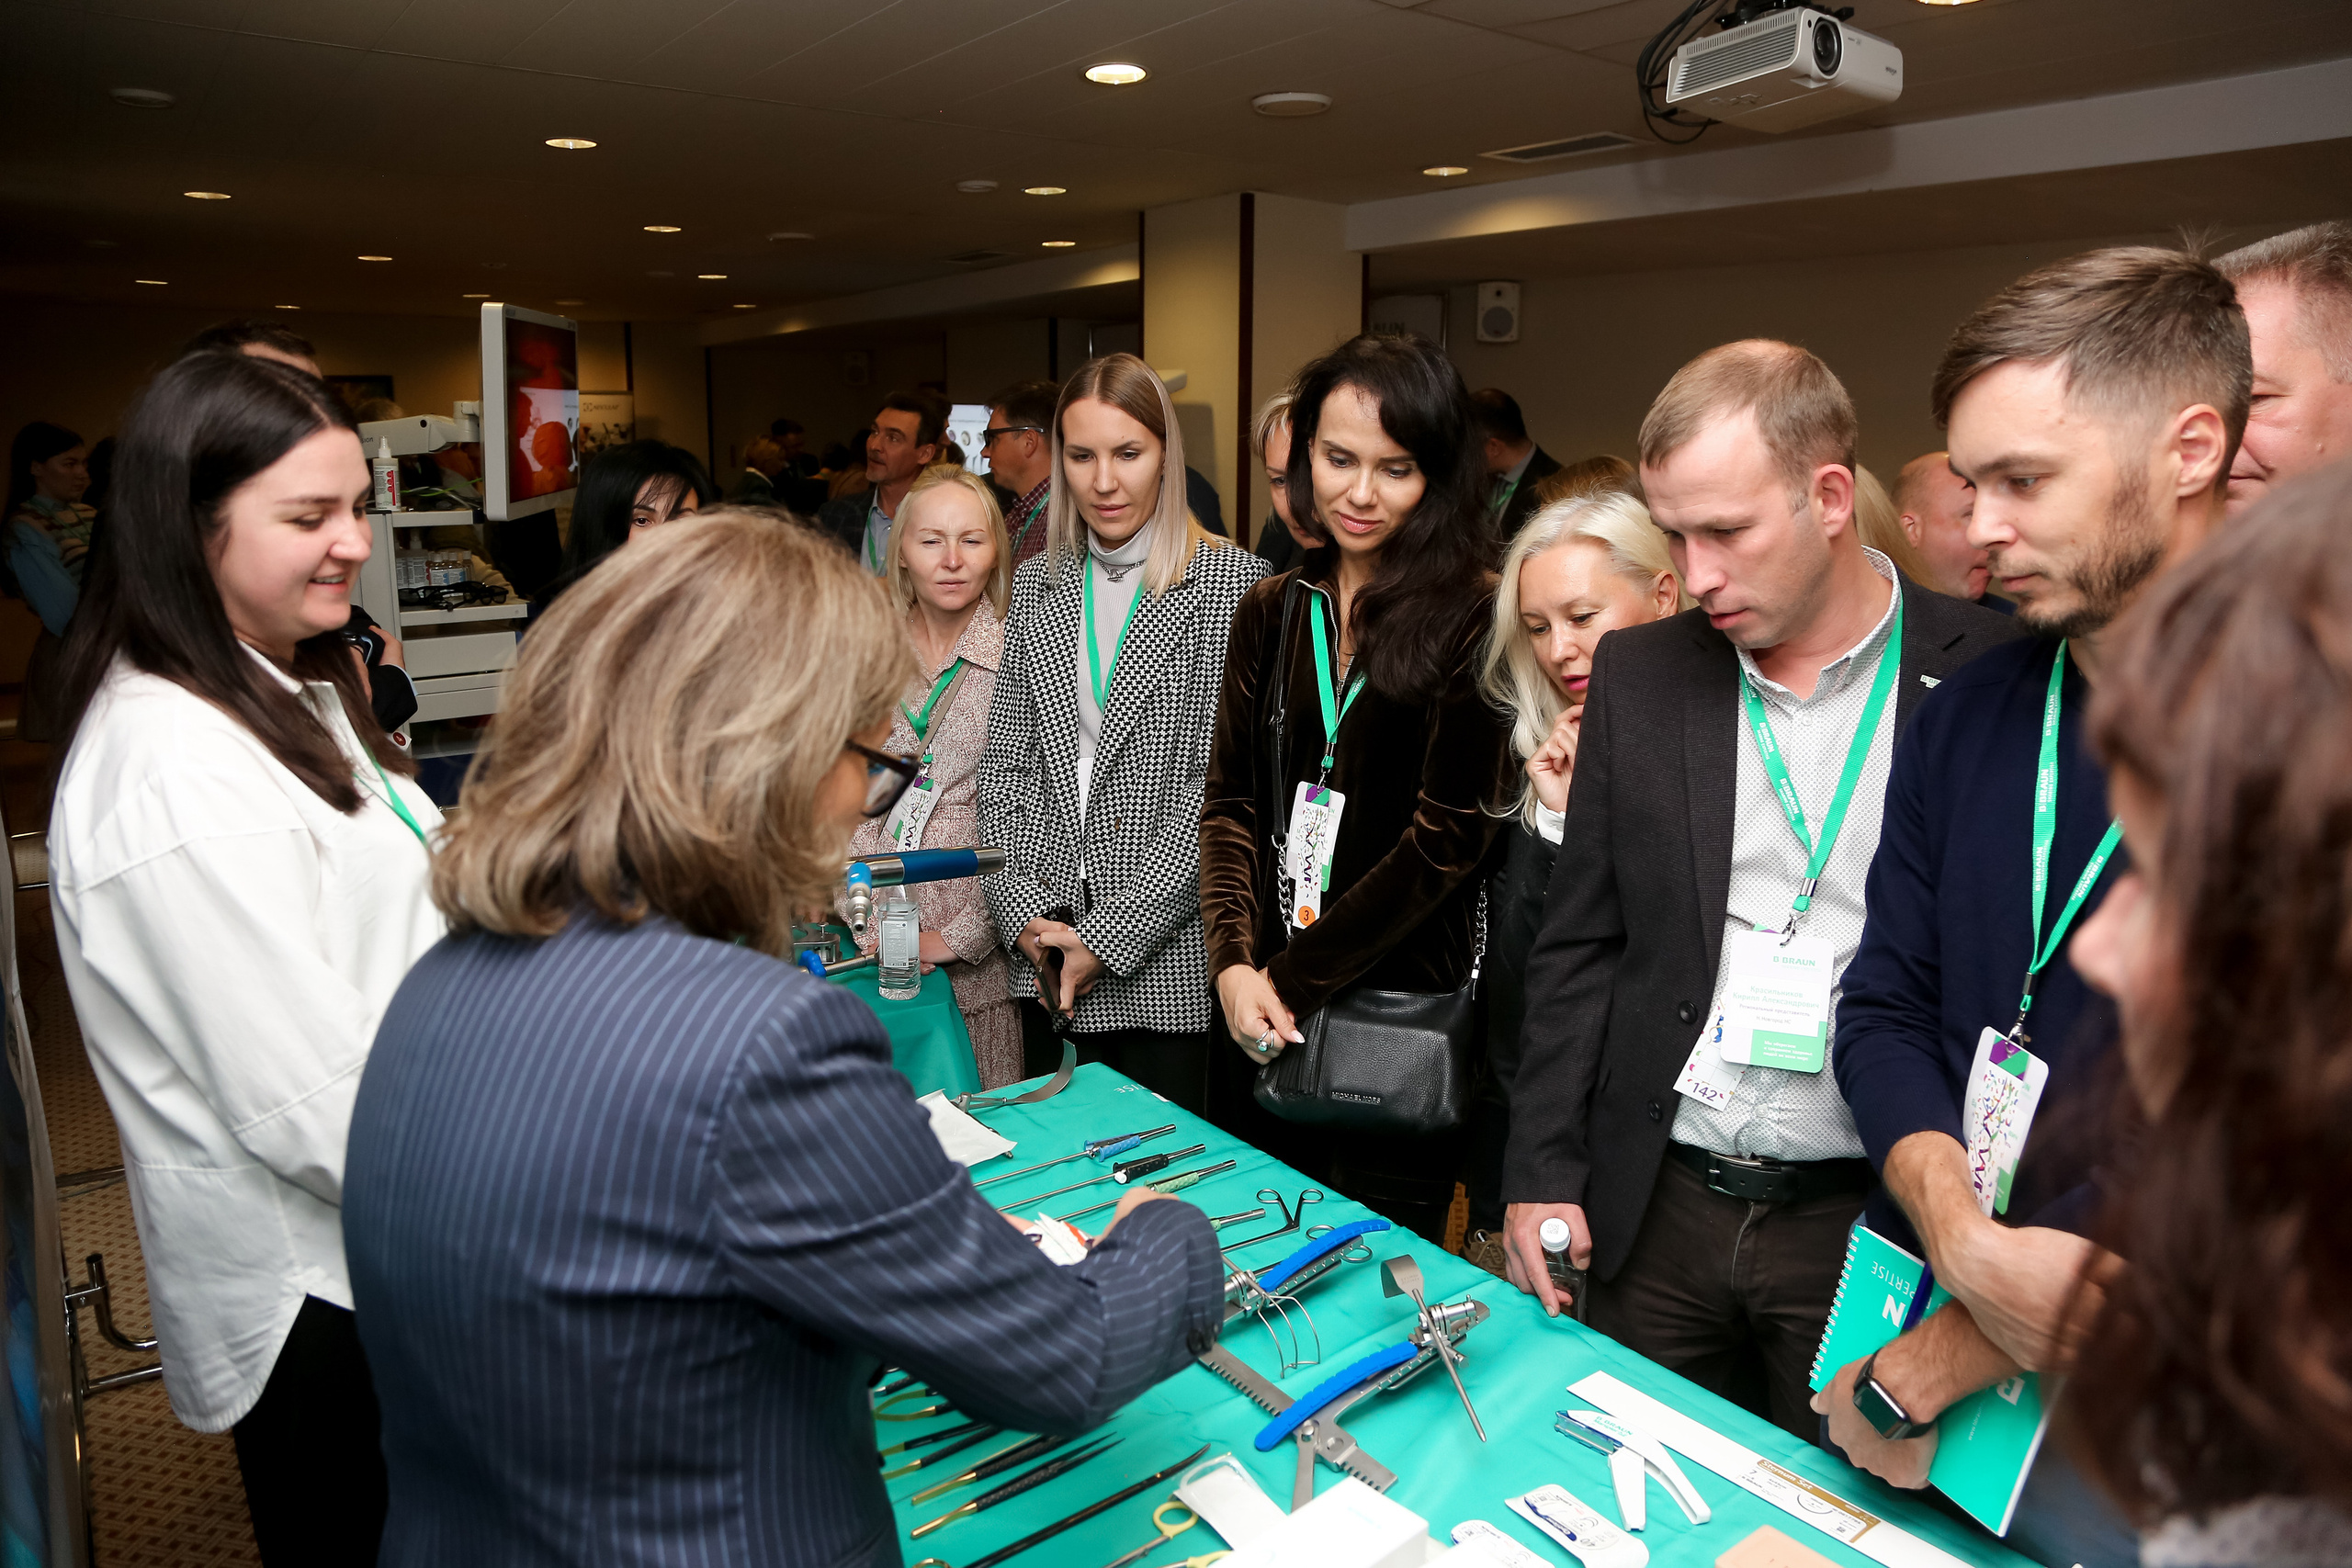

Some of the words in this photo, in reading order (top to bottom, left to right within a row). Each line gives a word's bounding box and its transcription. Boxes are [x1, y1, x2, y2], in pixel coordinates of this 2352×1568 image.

[1761, 727, 1775, 753] BRAUN
[2040, 769, 2049, 804] BRAUN
[1783, 784, 1800, 815] BRAUN
[2077, 864, 2099, 898] BRAUN
[1304, 910, 1310, 921] 3
[1782, 957, 1816, 966] BRAUN
[1733, 992, 1760, 1002] Кирилл
[1762, 996, 1820, 1010] Александрович
[1750, 986, 1804, 998] Красильников
[1693, 1083, 1718, 1102] 142
[1762, 1461, 1797, 1482] Sternum
[1797, 1480, 1814, 1490] Set
